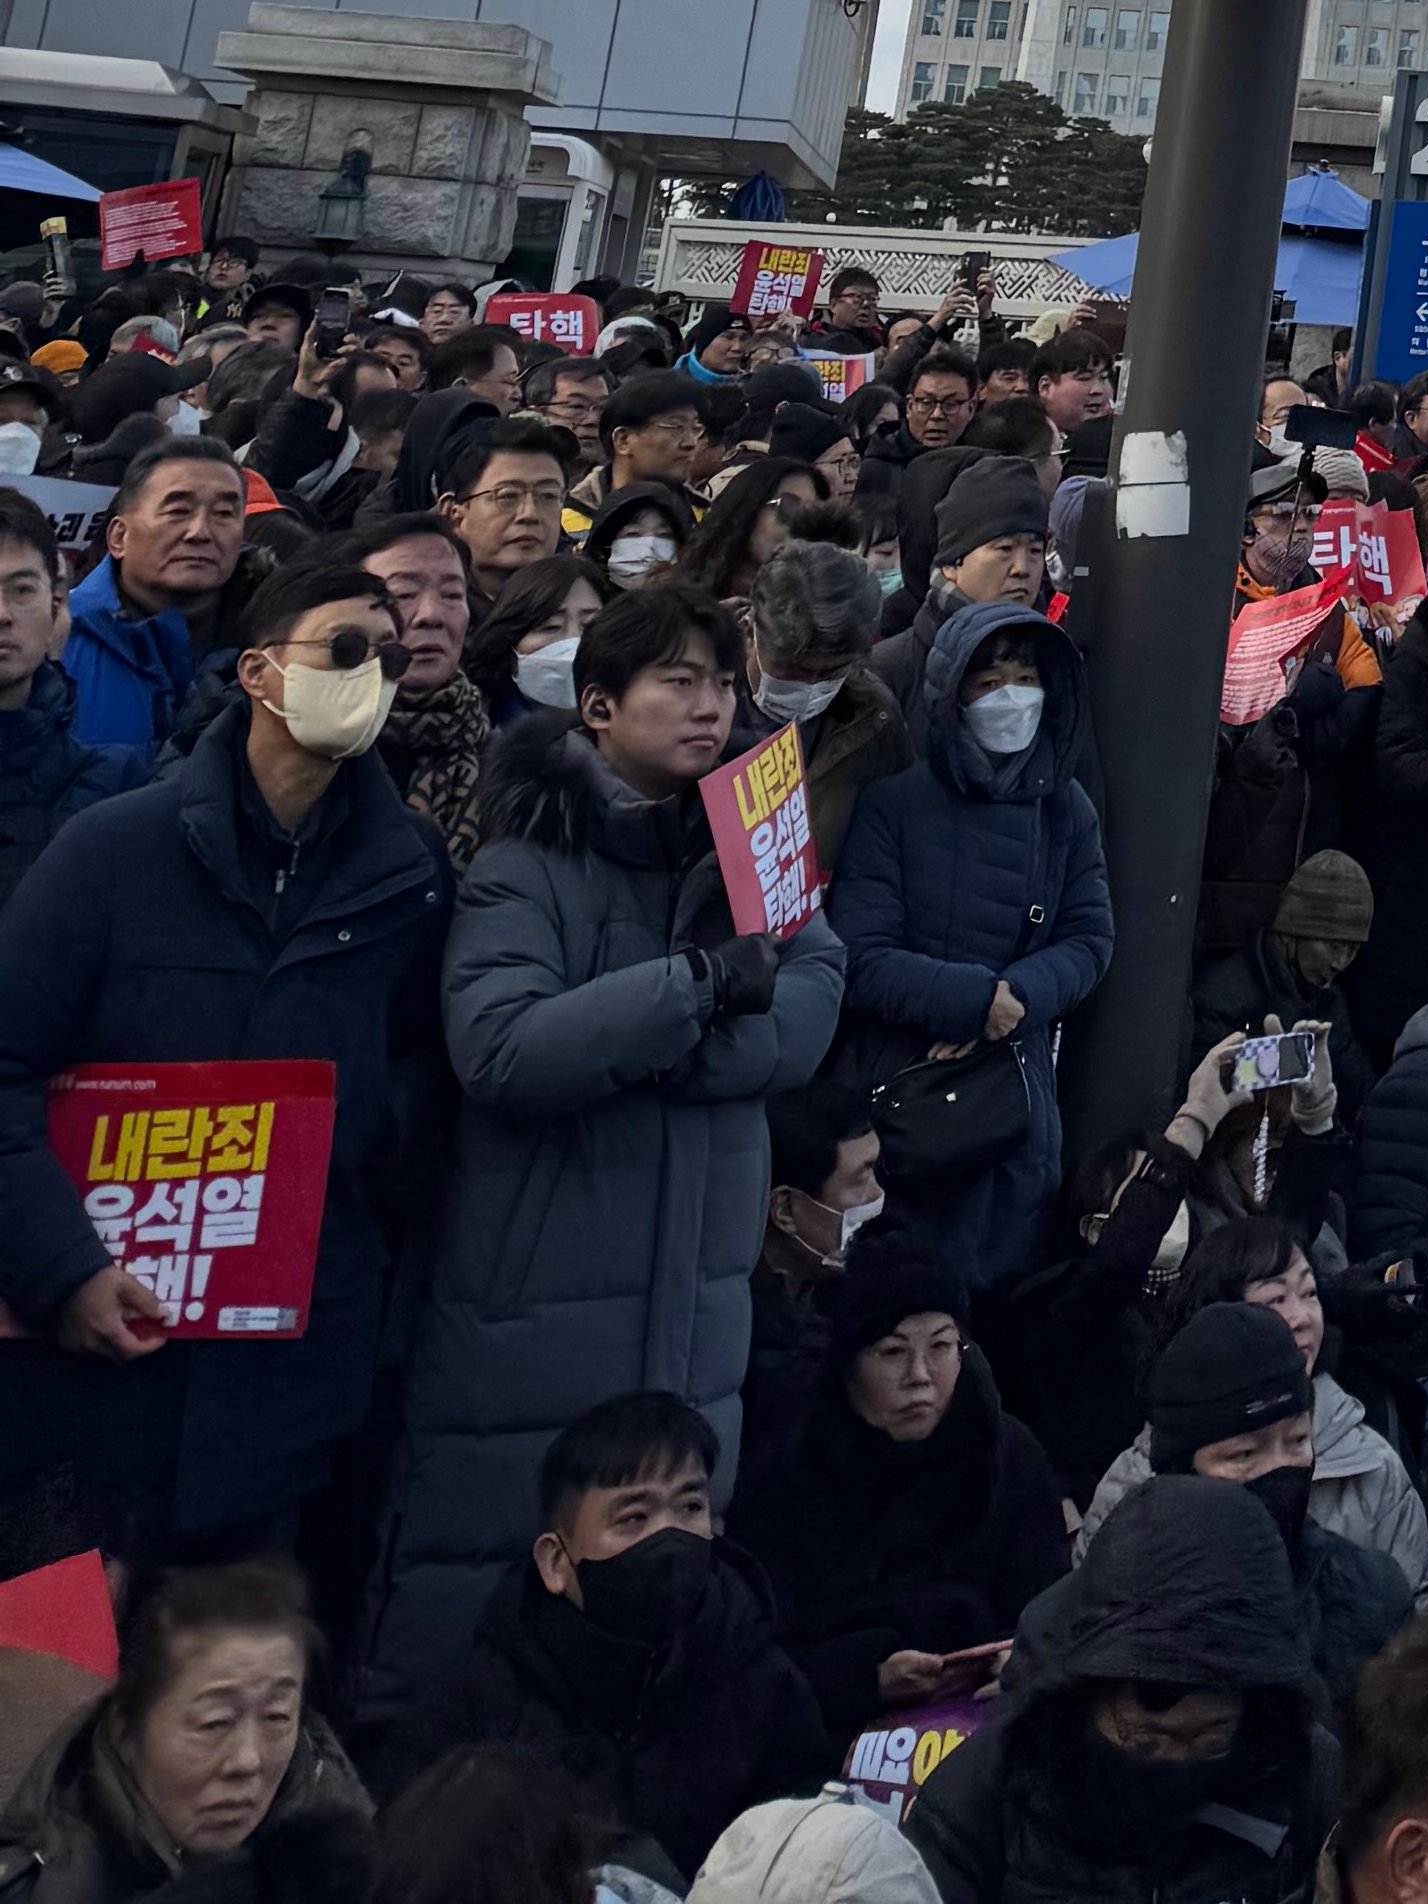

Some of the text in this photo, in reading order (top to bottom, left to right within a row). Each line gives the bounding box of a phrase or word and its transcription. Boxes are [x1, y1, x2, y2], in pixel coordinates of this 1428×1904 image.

[509, 309, 584, 351] 탄핵
[811, 359, 846, 382] 란죄
[732, 721, 802, 832] 내란죄
[750, 781, 811, 893] 윤석열
[763, 855, 809, 931] 탄핵!
[87, 1101, 276, 1182] 내란죄
[84, 1174, 266, 1256] 윤석열
[112, 1253, 214, 1328] 핵!
